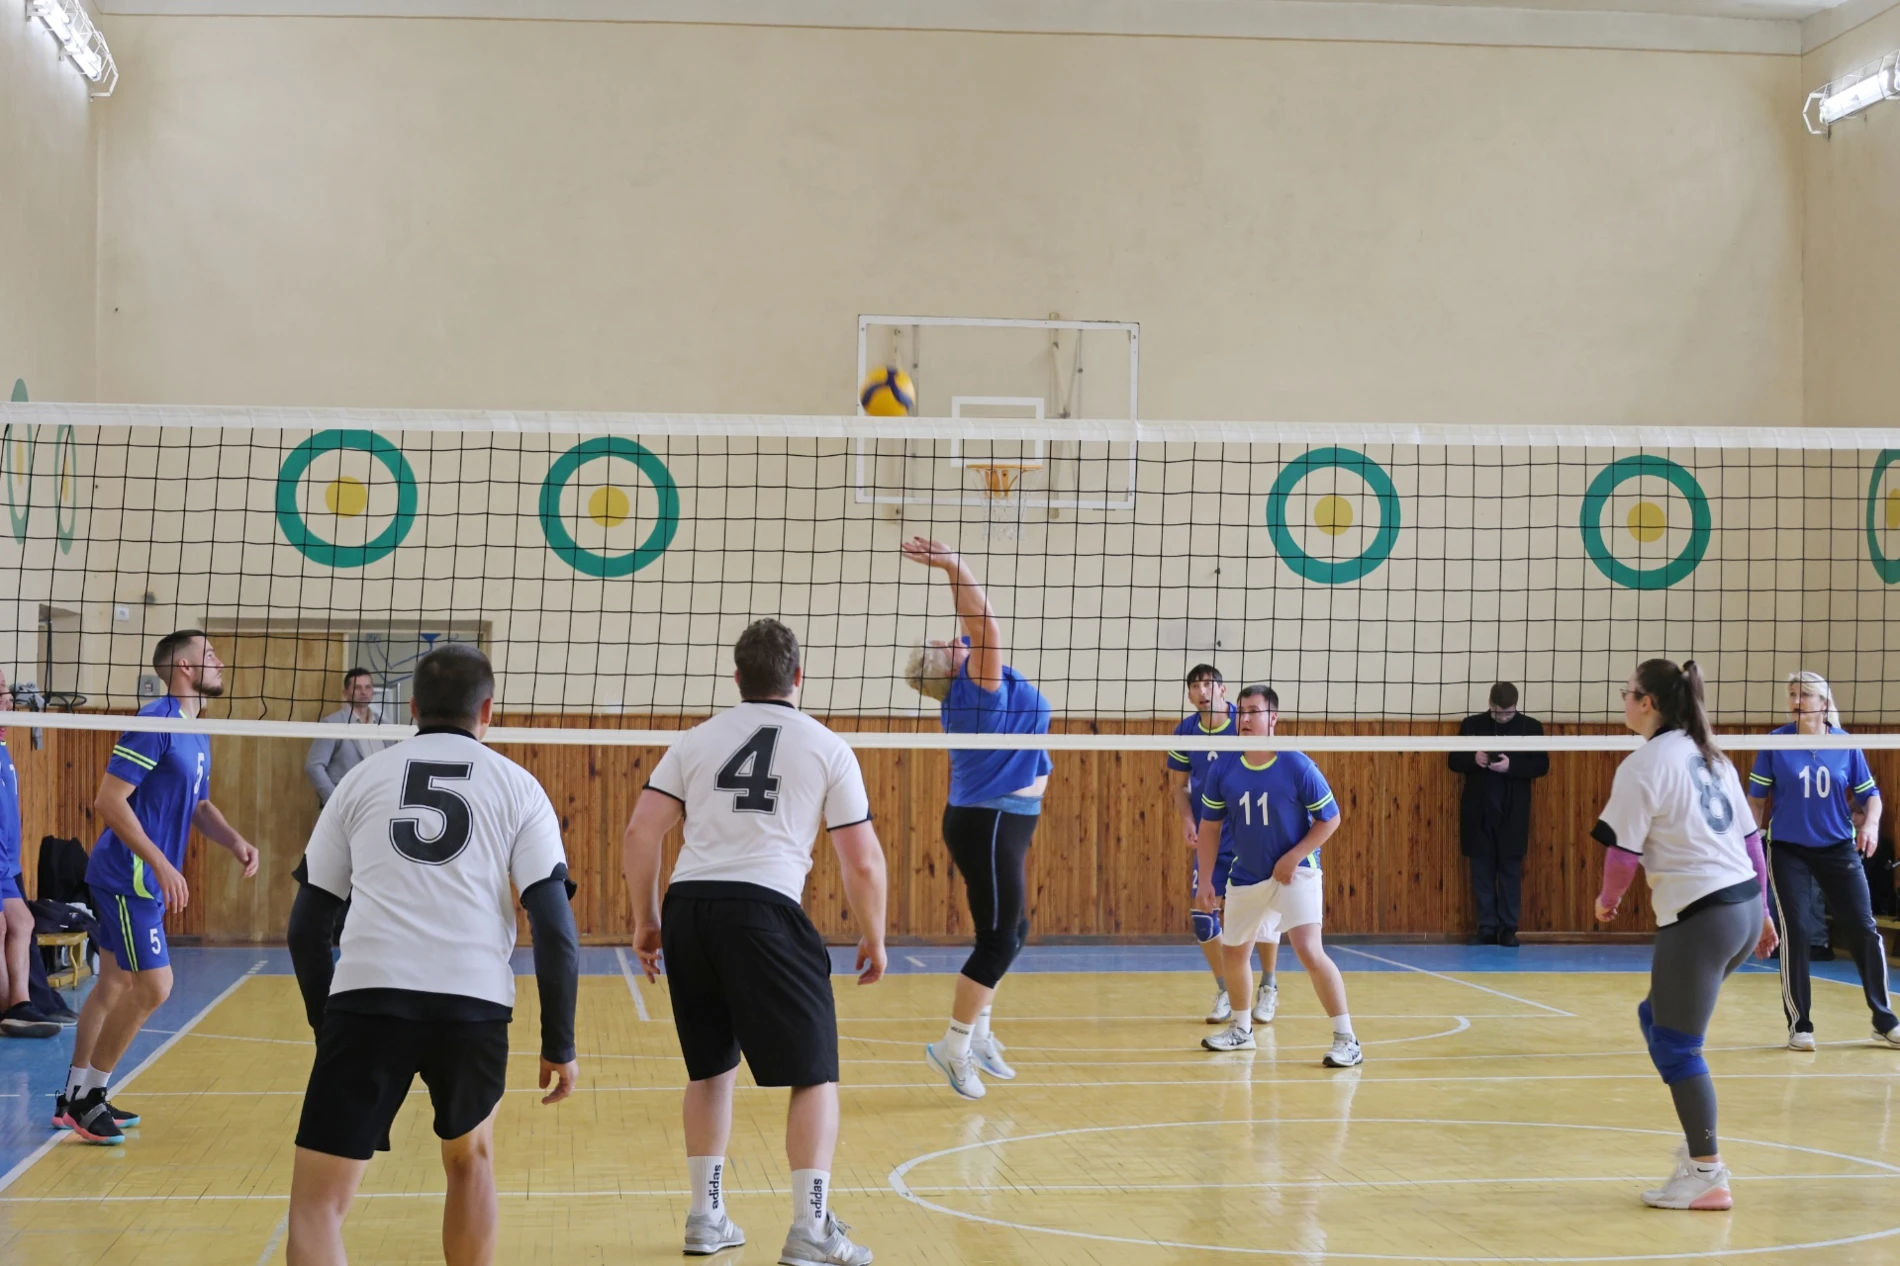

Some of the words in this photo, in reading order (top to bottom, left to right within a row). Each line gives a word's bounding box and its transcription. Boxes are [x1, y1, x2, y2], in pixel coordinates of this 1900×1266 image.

[193, 752, 205, 795] 5
[714, 724, 782, 815] 4
[1799, 765, 1831, 798] 10
[389, 759, 473, 866] 5
[1239, 791, 1269, 826] 11
[1685, 753, 1733, 835] 8
[149, 928, 161, 955] 5
[708, 1164, 721, 1210] adidas
[809, 1178, 823, 1219] adidas
